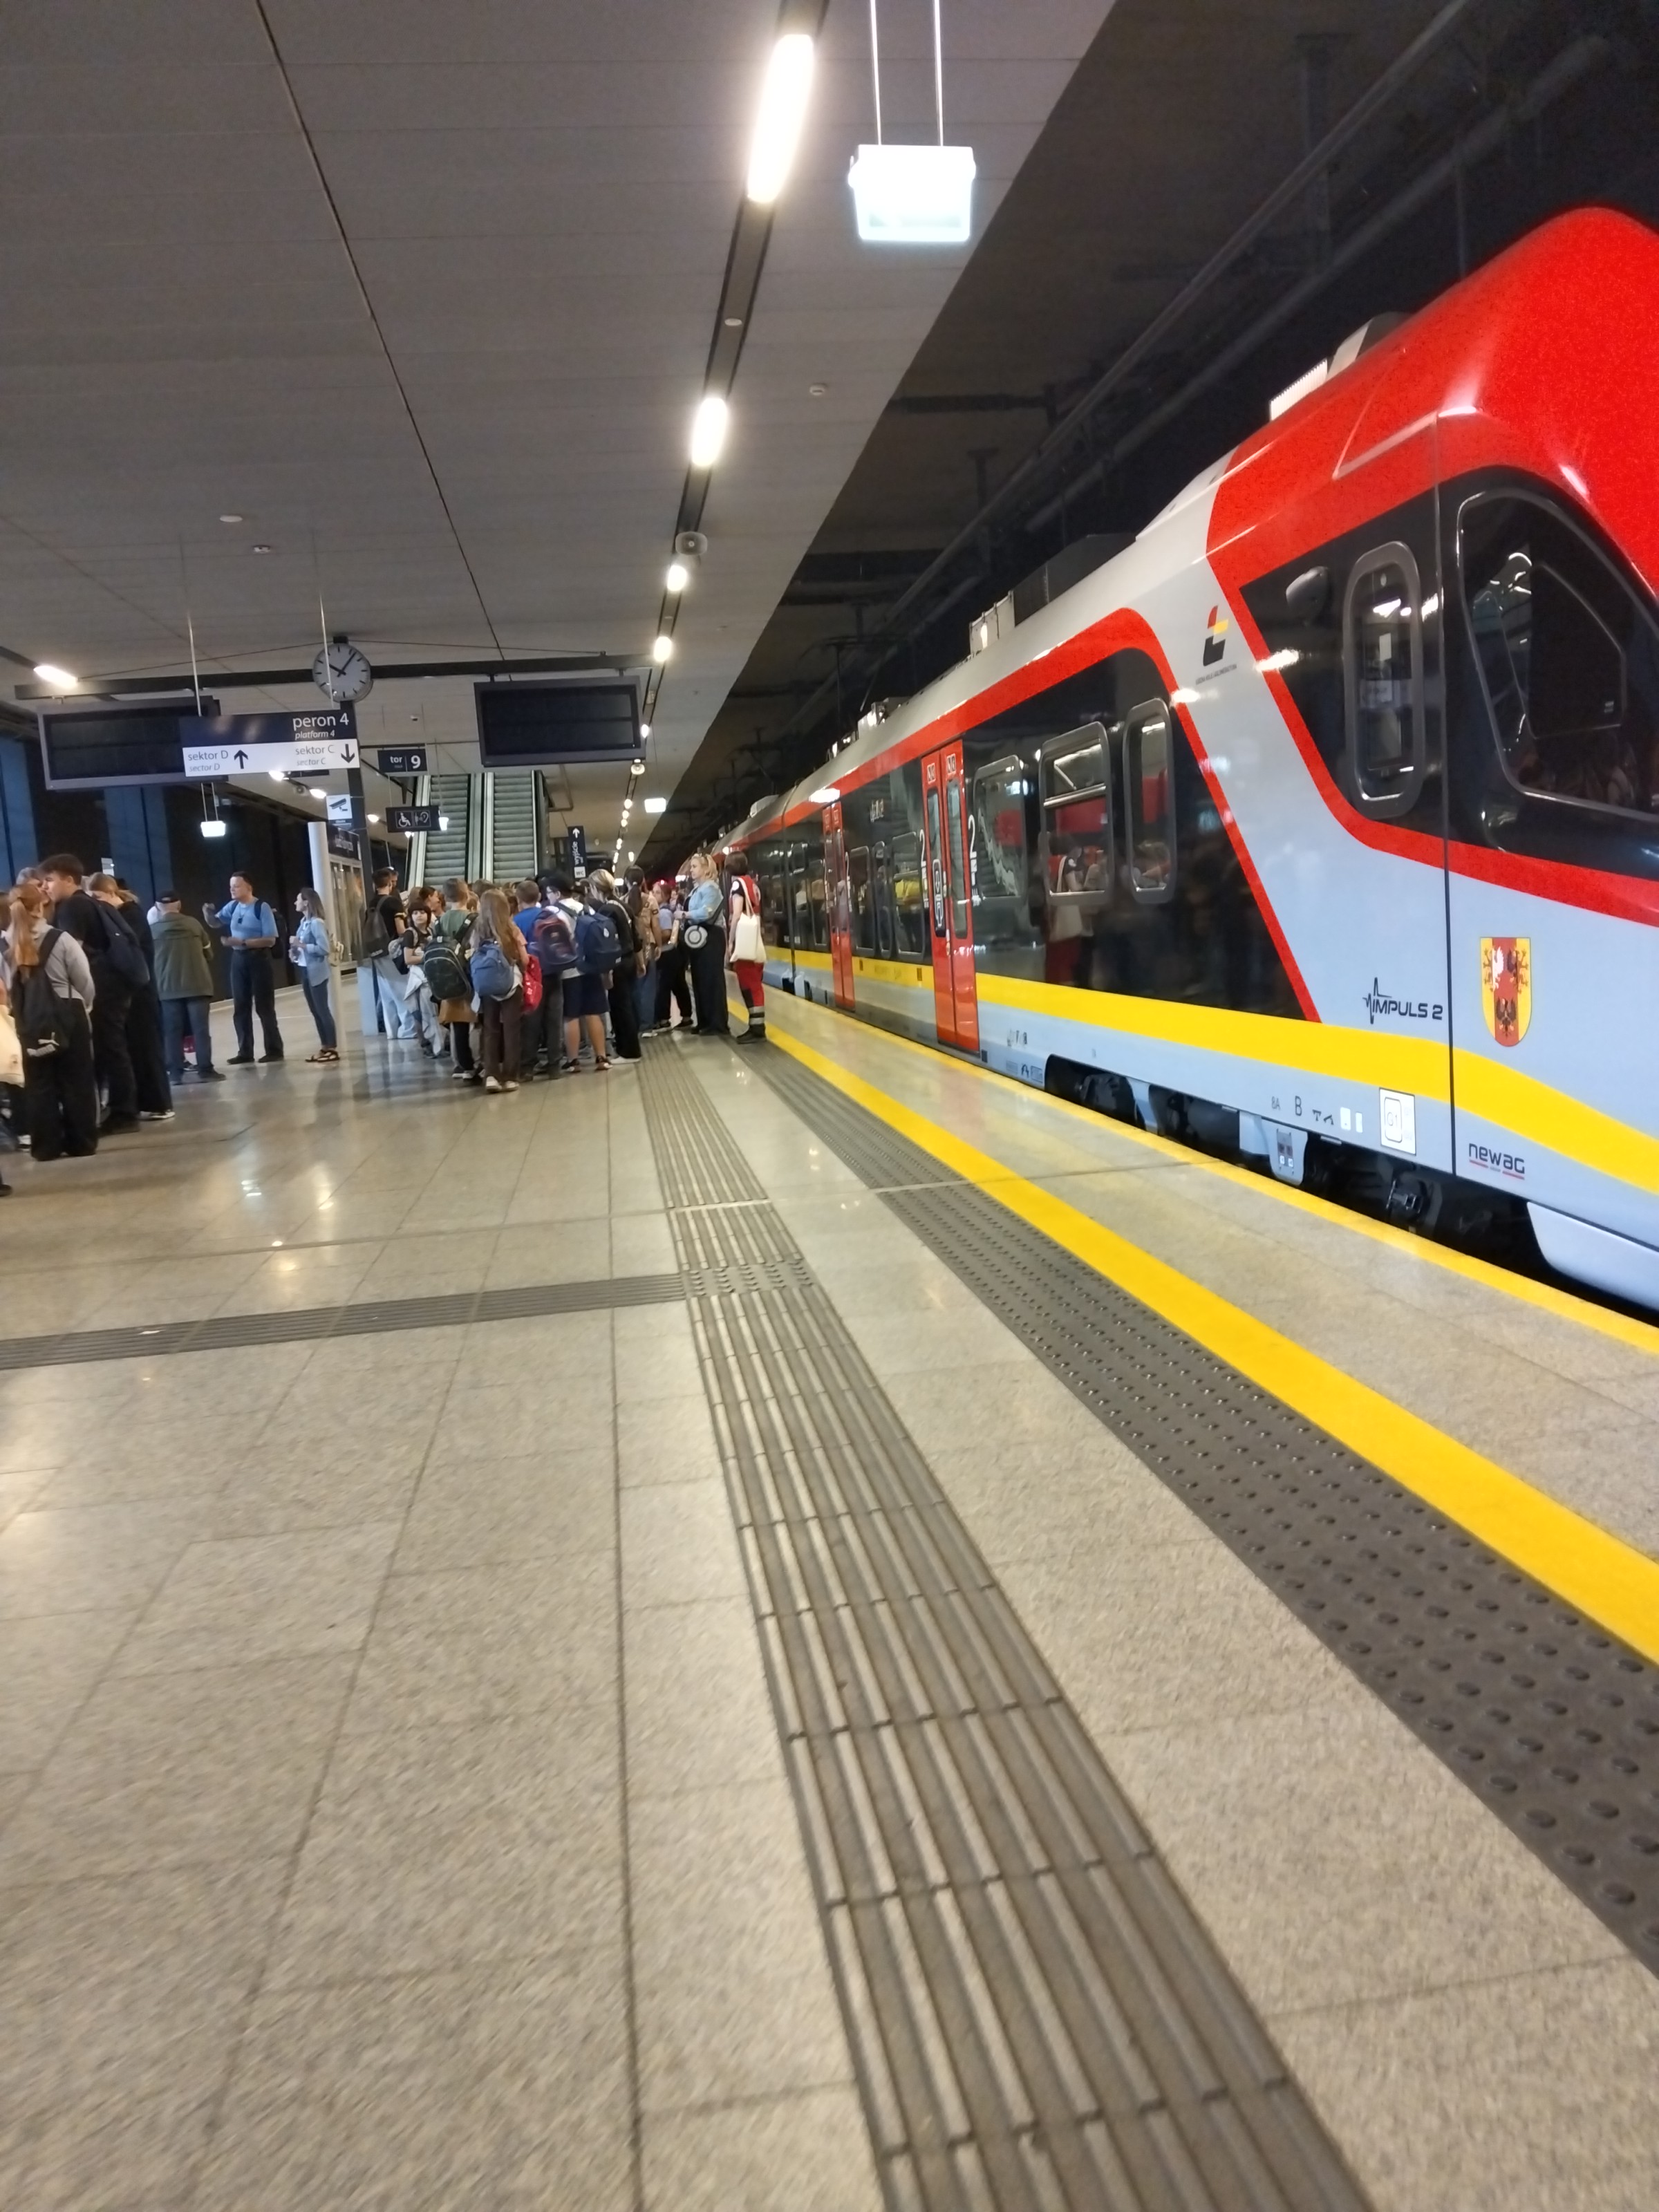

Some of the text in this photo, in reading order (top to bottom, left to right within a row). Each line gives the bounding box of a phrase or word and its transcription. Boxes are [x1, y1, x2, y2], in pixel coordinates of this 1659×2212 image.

[292, 713, 349, 731] peron 4
[294, 729, 335, 741] platform 4
[187, 750, 229, 761] sektor D
[295, 744, 335, 756] sektor C
[297, 758, 319, 767] sector
[411, 755, 421, 769] 9
[968, 814, 977, 859] 2
[1432, 1004, 1443, 1021] 2
[1295, 1095, 1302, 1116] B
